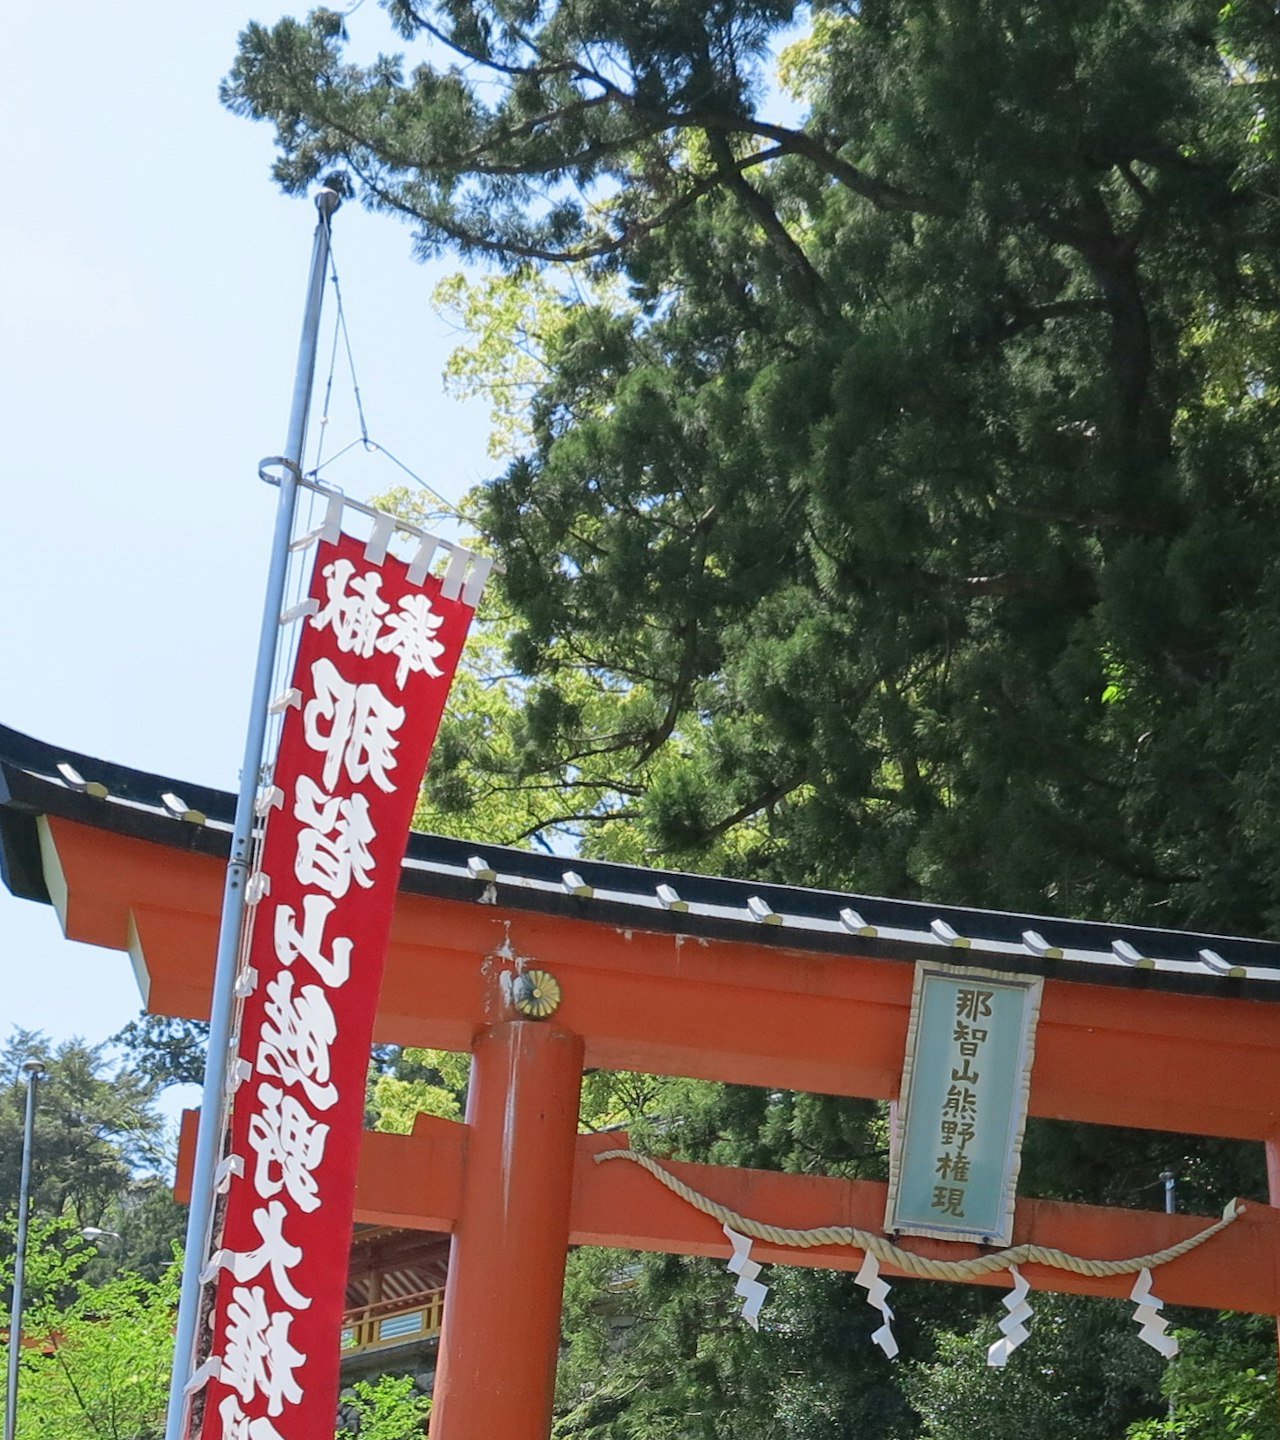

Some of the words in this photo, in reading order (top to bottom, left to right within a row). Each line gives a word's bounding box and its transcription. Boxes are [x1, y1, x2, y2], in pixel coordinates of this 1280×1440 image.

[931, 988, 994, 1218] 那智山熊野権現
